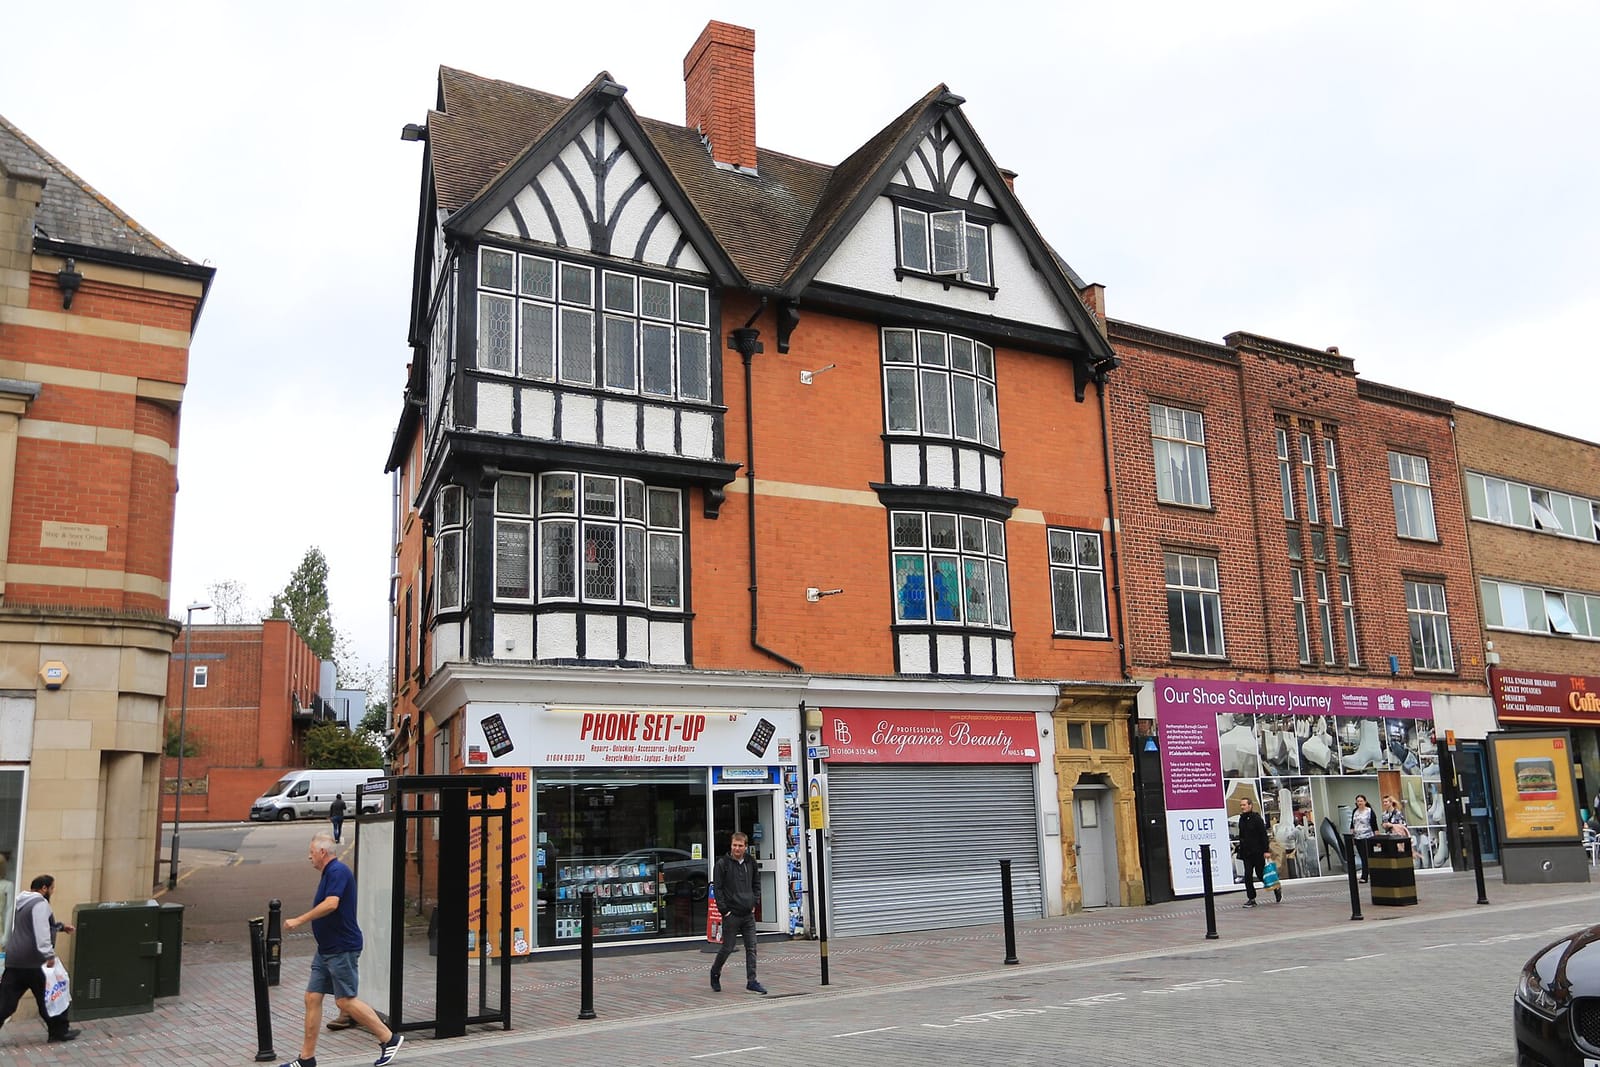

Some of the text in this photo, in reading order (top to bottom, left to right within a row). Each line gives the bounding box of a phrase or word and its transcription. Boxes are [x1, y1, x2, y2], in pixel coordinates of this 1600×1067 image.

[1502, 676, 1557, 687] FULL ENGLISH BREAKFAST
[1569, 677, 1586, 690] THE
[1521, 687, 1542, 695] POTATOES
[1164, 686, 1332, 711] Our Shoe Sculpture Journey
[1342, 693, 1368, 702] Northampton
[1505, 694, 1527, 702] DESSERTS
[1506, 703, 1561, 713] LOCALLY ROASTED COFFEE
[580, 713, 706, 741] PHONE SET-UP
[896, 726, 942, 734] PROFESSIONAL
[871, 720, 1013, 755] Elegance Beauty
[590, 744, 609, 753] Repairs
[612, 744, 635, 753] Unlocking
[678, 745, 695, 753] Repairs
[605, 754, 622, 762] Recycle
[726, 767, 765, 777] Lycamobile
[515, 784, 528, 793] UP
[1179, 818, 1214, 832] TO LET
[1181, 833, 1190, 841] ALL
[1184, 847, 1218, 861] Chon
